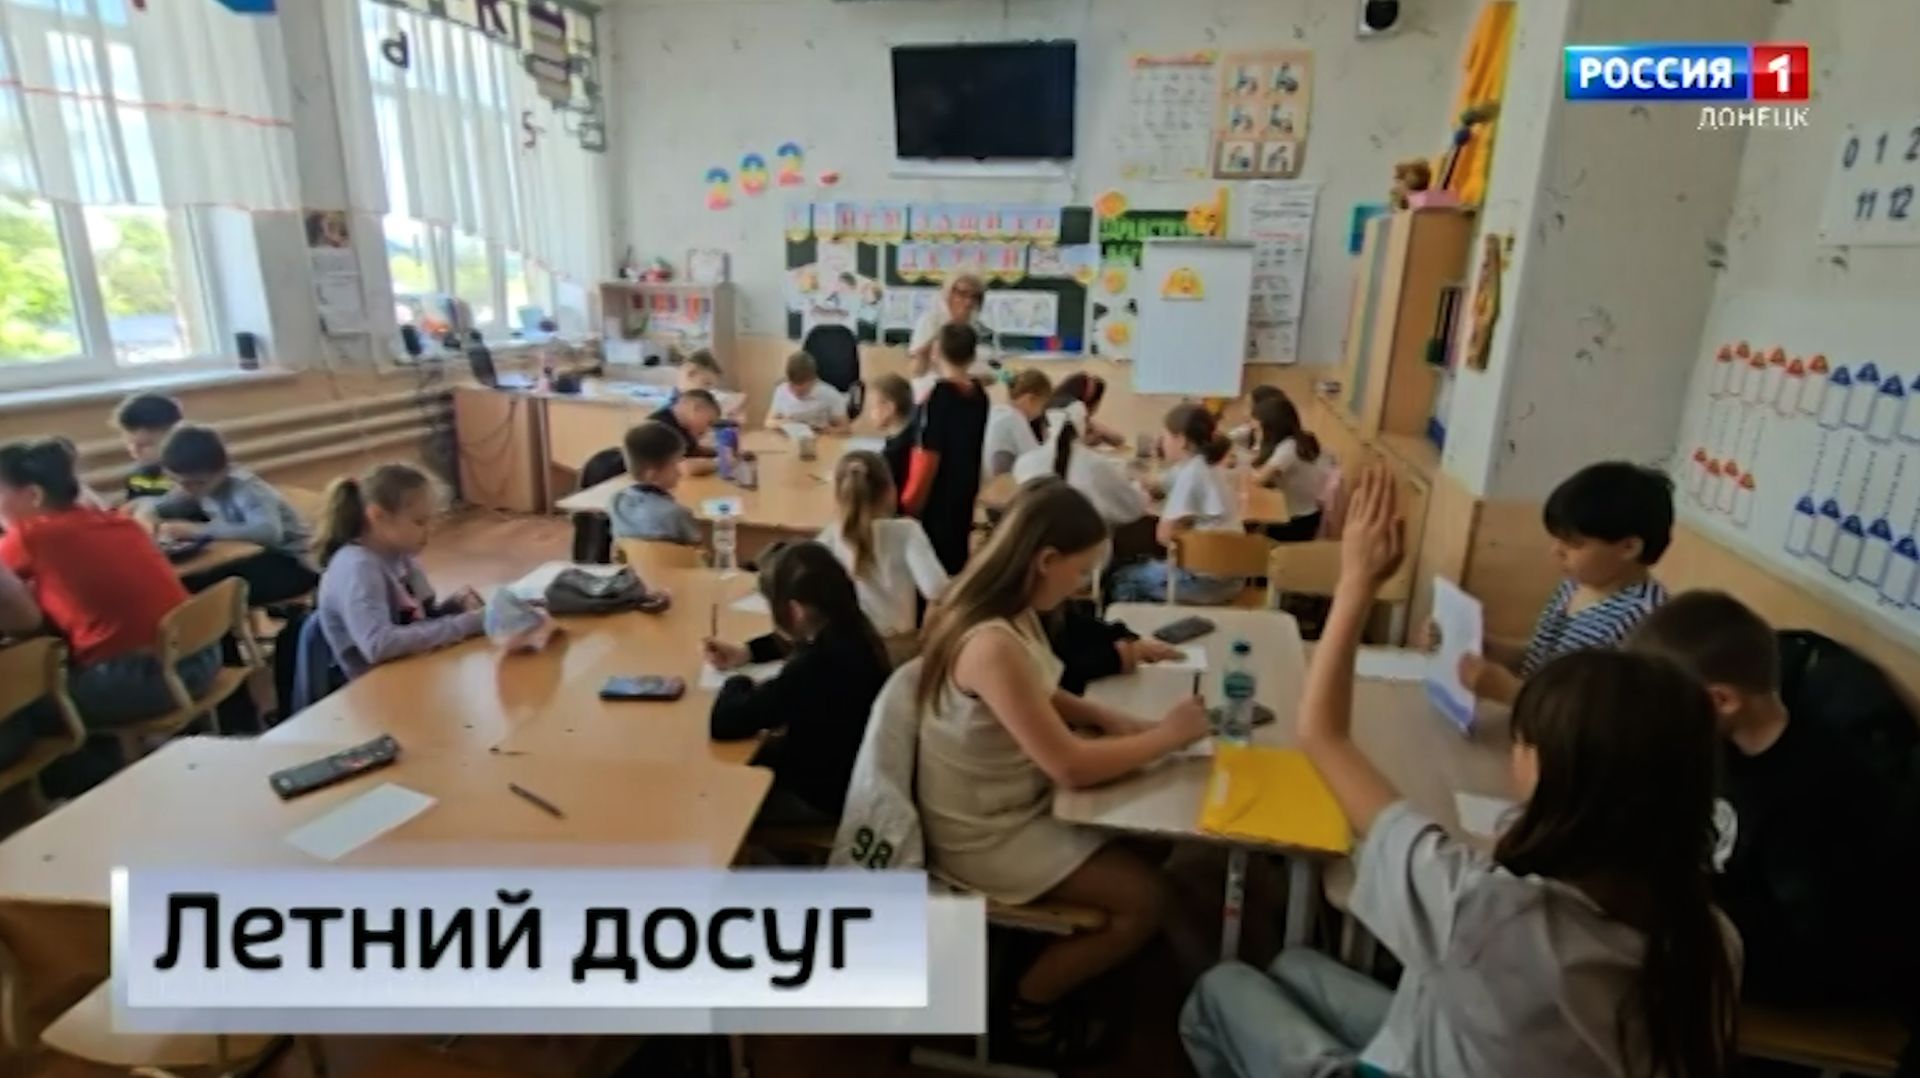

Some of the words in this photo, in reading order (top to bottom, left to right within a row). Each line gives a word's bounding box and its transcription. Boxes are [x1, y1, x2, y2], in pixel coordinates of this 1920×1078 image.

[1842, 137, 1859, 168] 0
[1855, 187, 1879, 219] 11
[1887, 184, 1914, 220] 12
